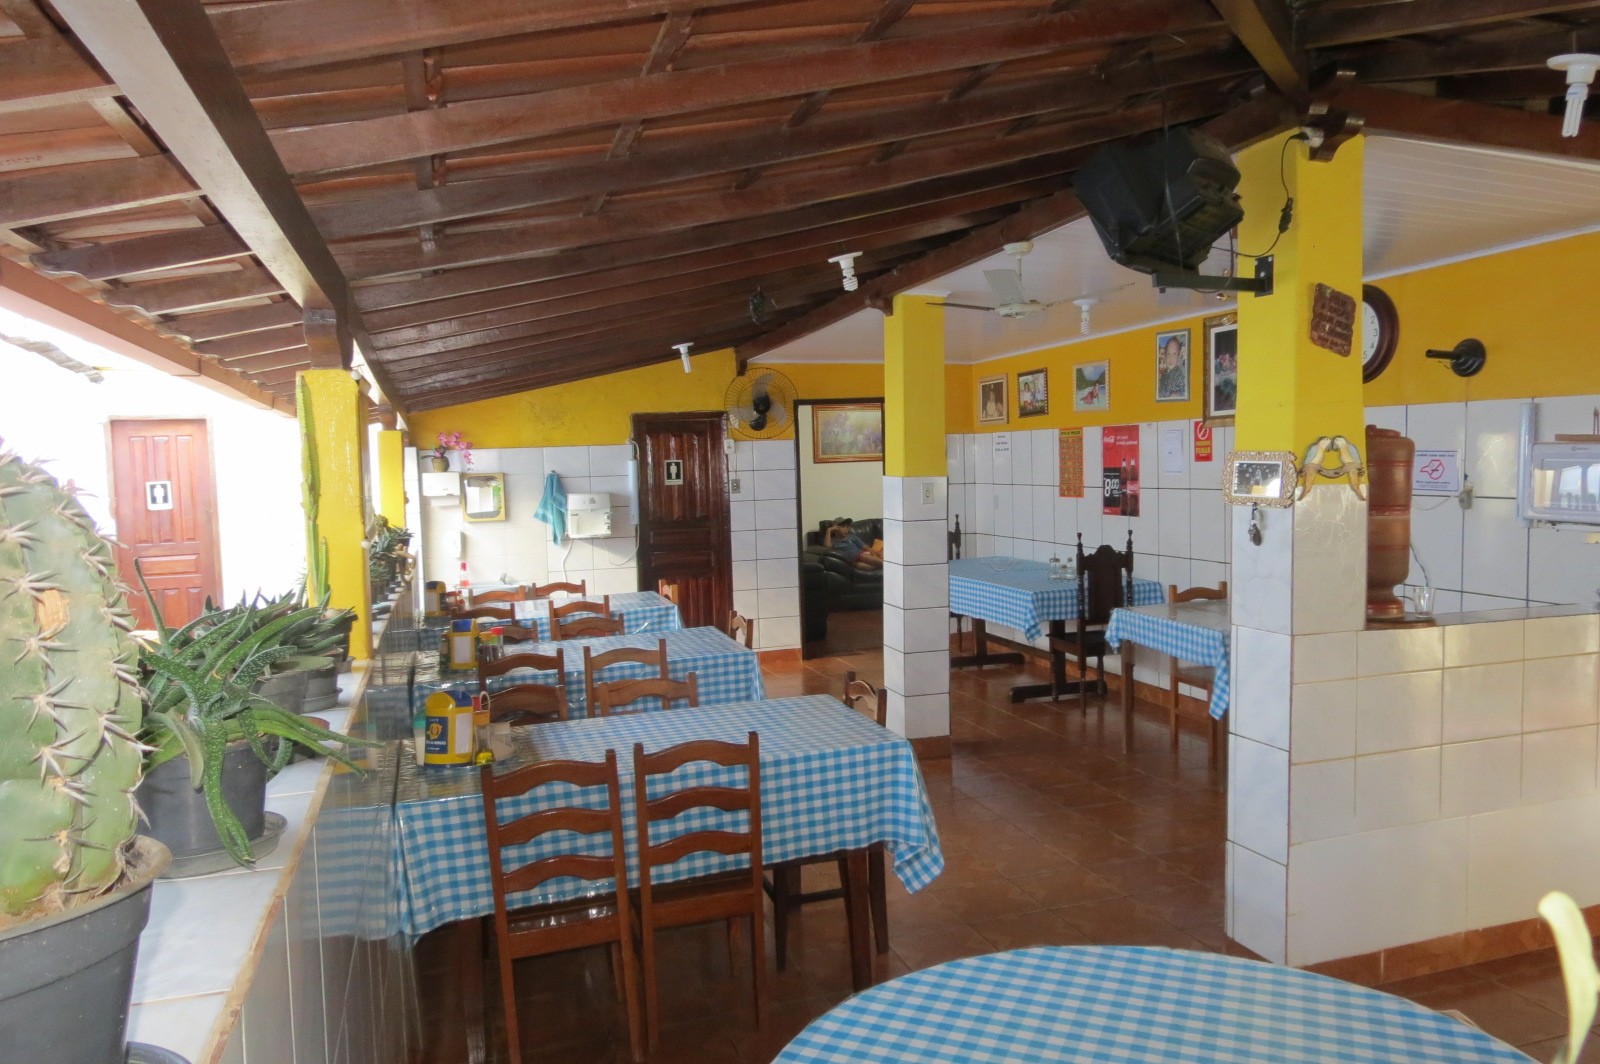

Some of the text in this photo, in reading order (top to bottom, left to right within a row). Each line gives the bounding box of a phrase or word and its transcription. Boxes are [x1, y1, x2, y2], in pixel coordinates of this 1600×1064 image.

[1370, 315, 1376, 324] 2
[1373, 328, 1378, 337] 3
[1363, 351, 1368, 359] 5
